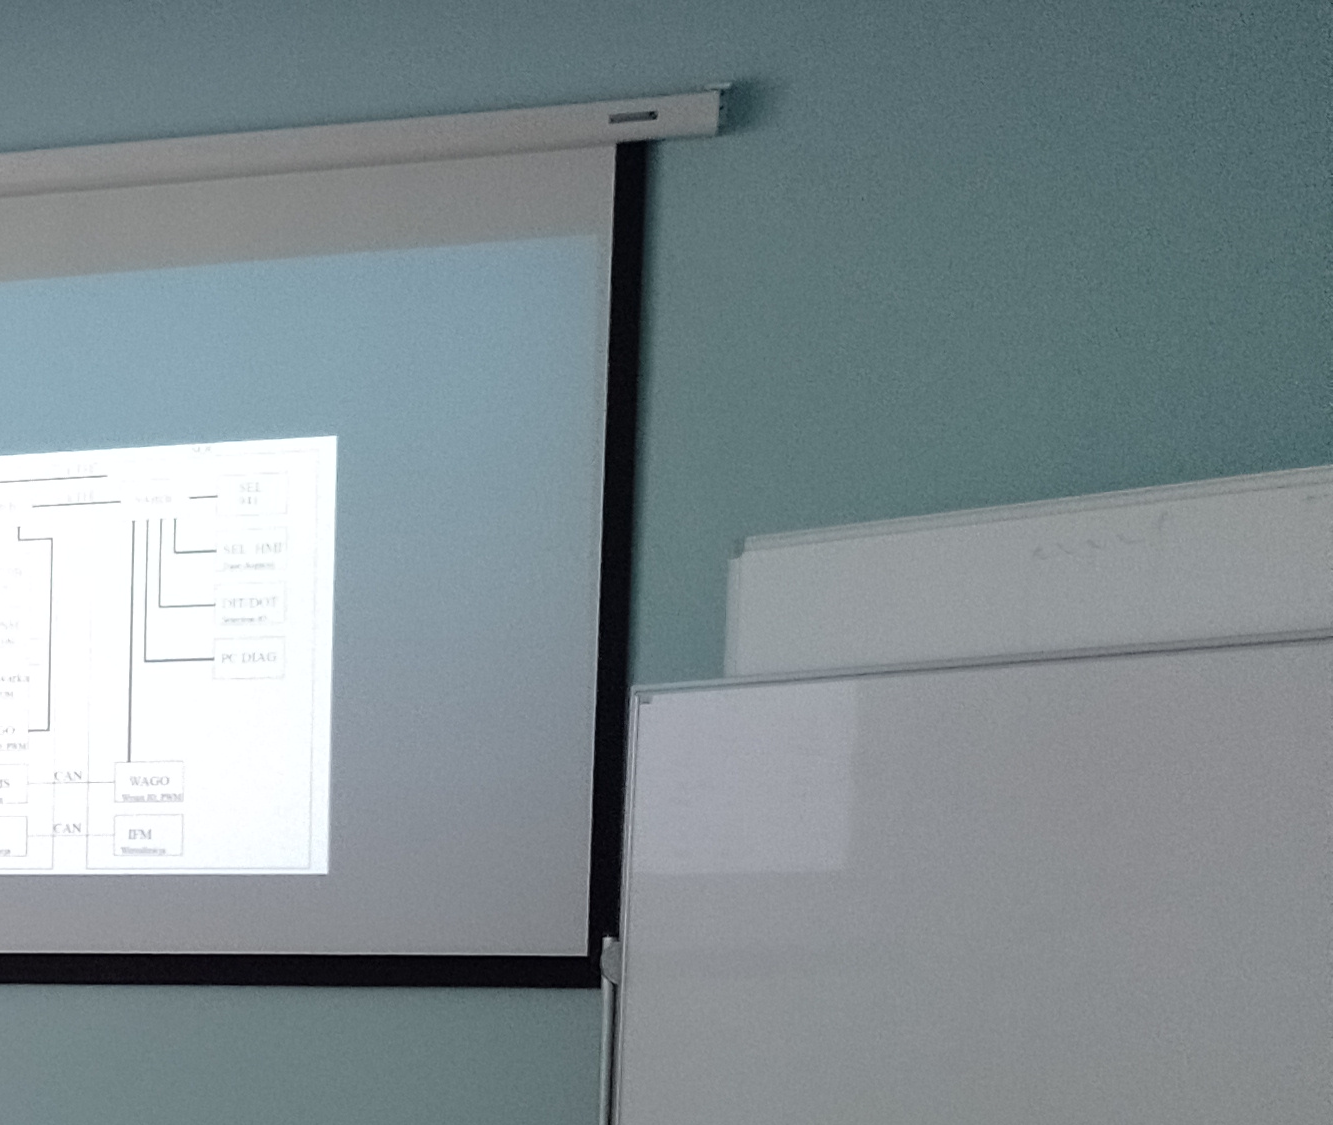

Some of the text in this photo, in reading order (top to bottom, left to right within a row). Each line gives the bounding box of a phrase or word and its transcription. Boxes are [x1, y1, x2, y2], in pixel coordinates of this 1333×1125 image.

[241, 650, 278, 664] DIAG
[53, 770, 84, 783] CAN
[129, 775, 171, 788] WAGO
[52, 822, 83, 835] CAN
[127, 827, 153, 841] IFM
